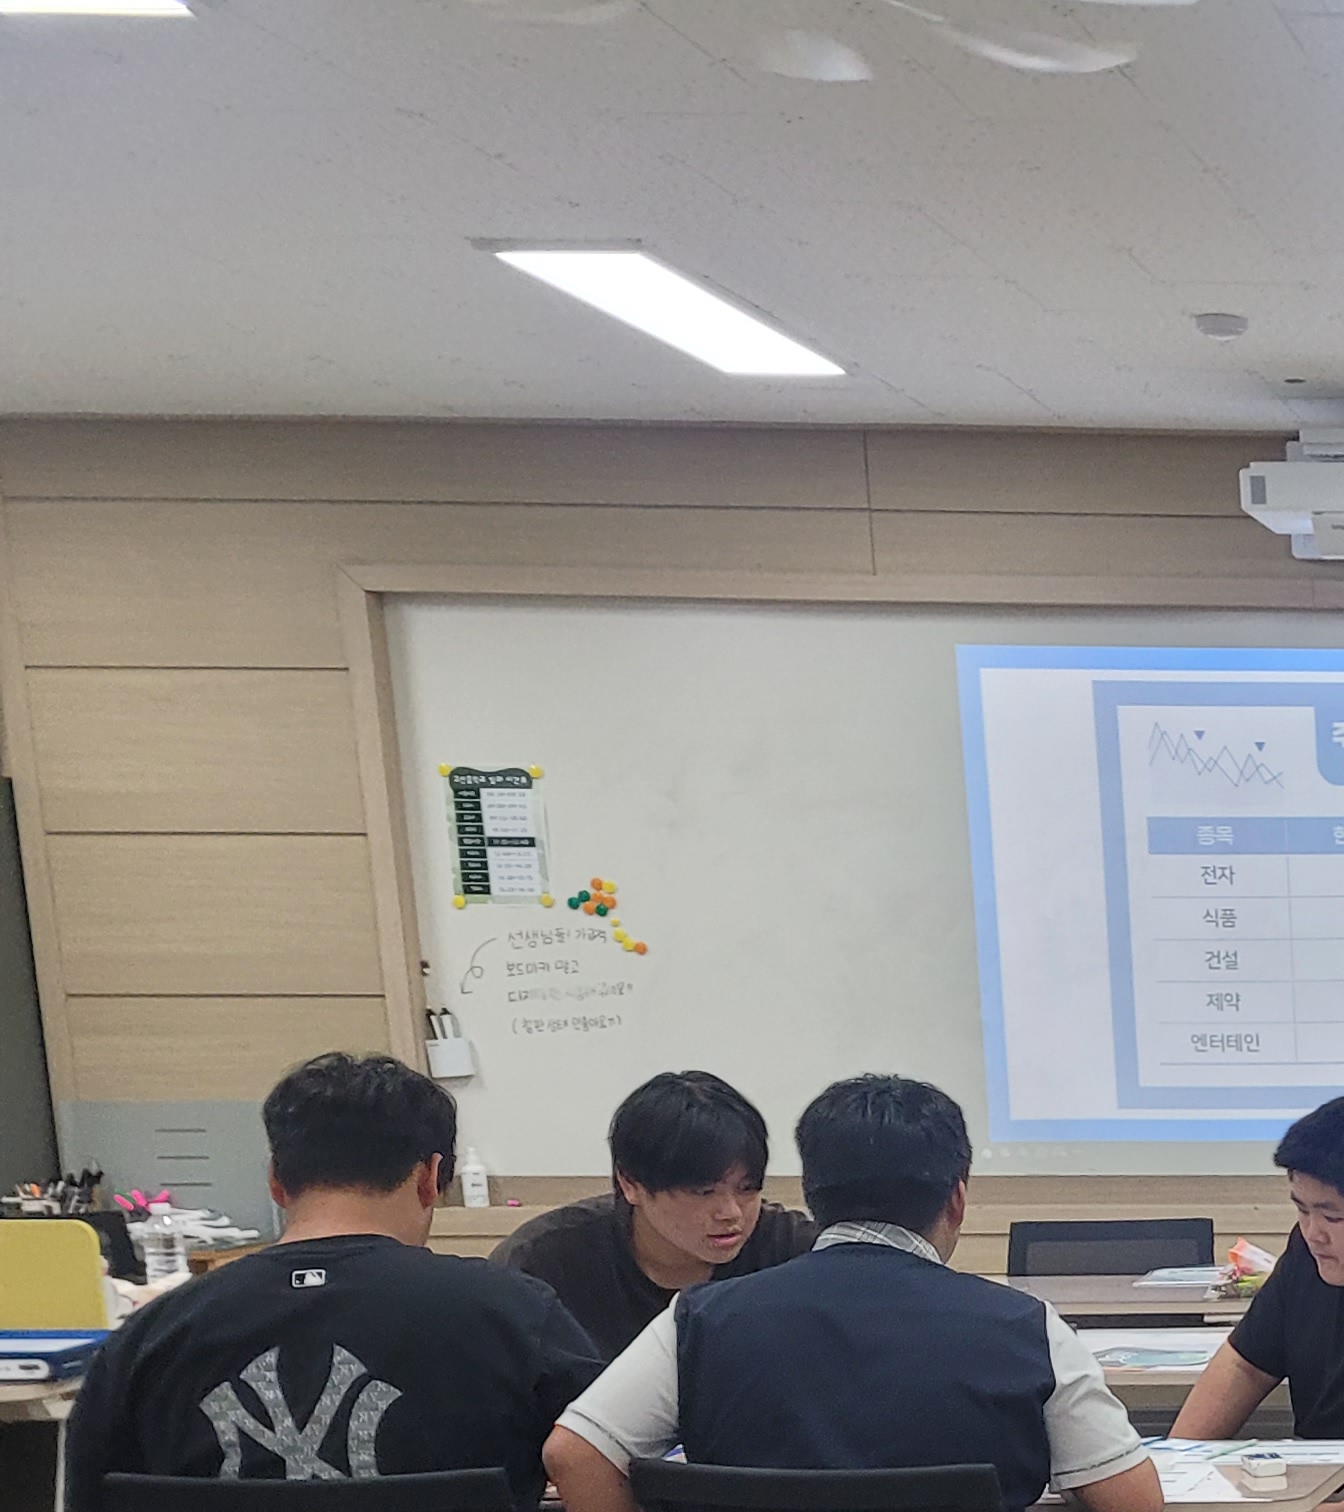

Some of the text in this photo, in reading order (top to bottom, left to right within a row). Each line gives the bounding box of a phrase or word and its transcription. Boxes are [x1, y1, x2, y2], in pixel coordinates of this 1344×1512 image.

[1197, 825, 1234, 846] 종목
[1200, 864, 1236, 886] 전자
[1202, 908, 1238, 929] 식품
[1204, 949, 1239, 971] 건설
[1206, 992, 1241, 1012] 제약
[1190, 1032, 1261, 1053] 엔터테인
[199, 1343, 403, 1481] NY
